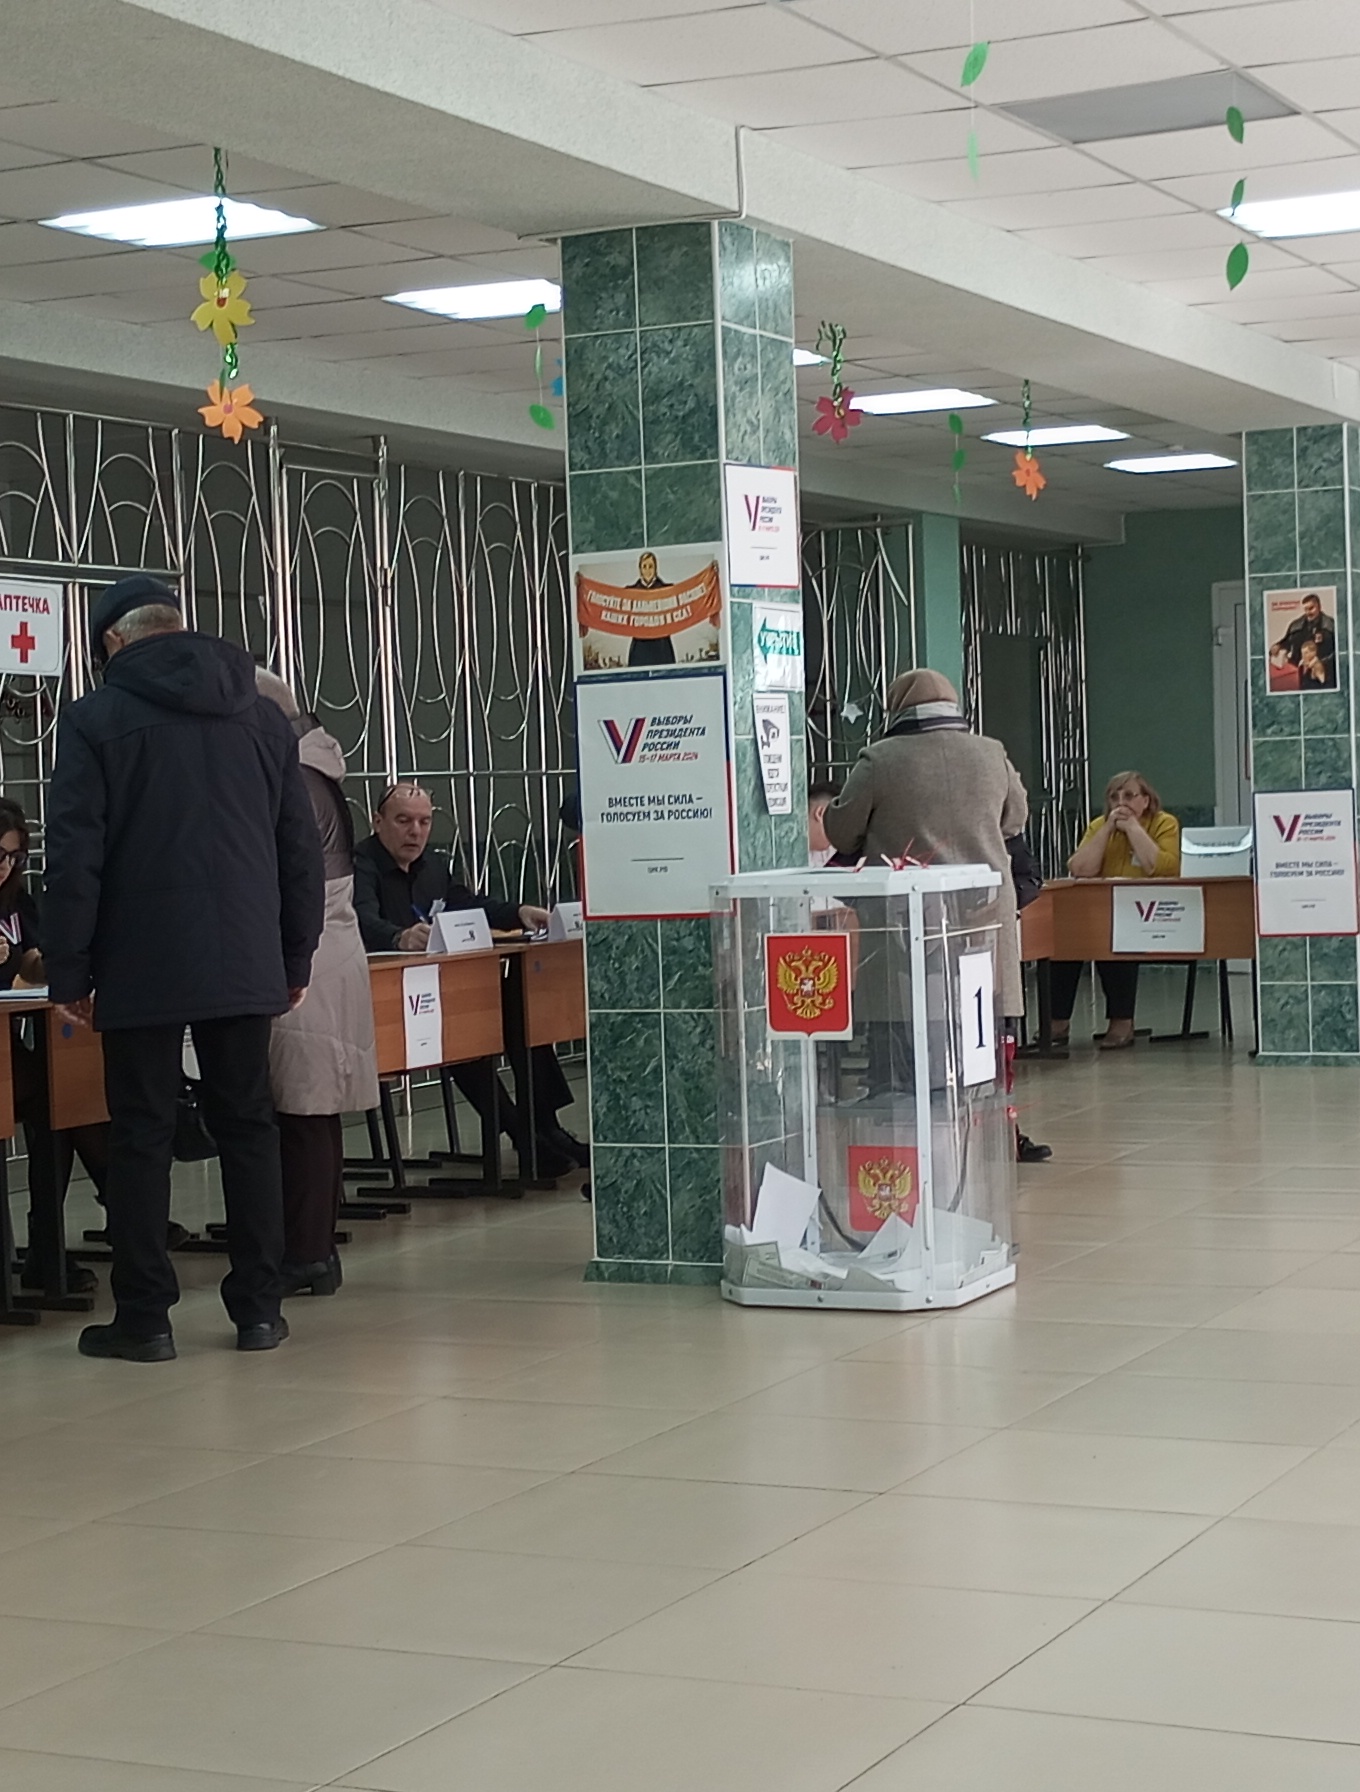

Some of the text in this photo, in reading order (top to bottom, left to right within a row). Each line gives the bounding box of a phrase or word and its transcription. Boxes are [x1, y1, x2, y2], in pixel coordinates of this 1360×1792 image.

[650, 714, 693, 727] ВЫБОРЫ
[646, 727, 707, 740] ПРЕЗИДЕНТА
[641, 741, 680, 752] РОССИИ
[608, 796, 645, 808] ВМЕСТЕ
[647, 795, 665, 806] МЫ
[668, 794, 694, 805] СИЛА
[601, 808, 712, 824] ГОЛОСУЕМ ЗА РОССИЮ!
[973, 986, 986, 1048] 1
